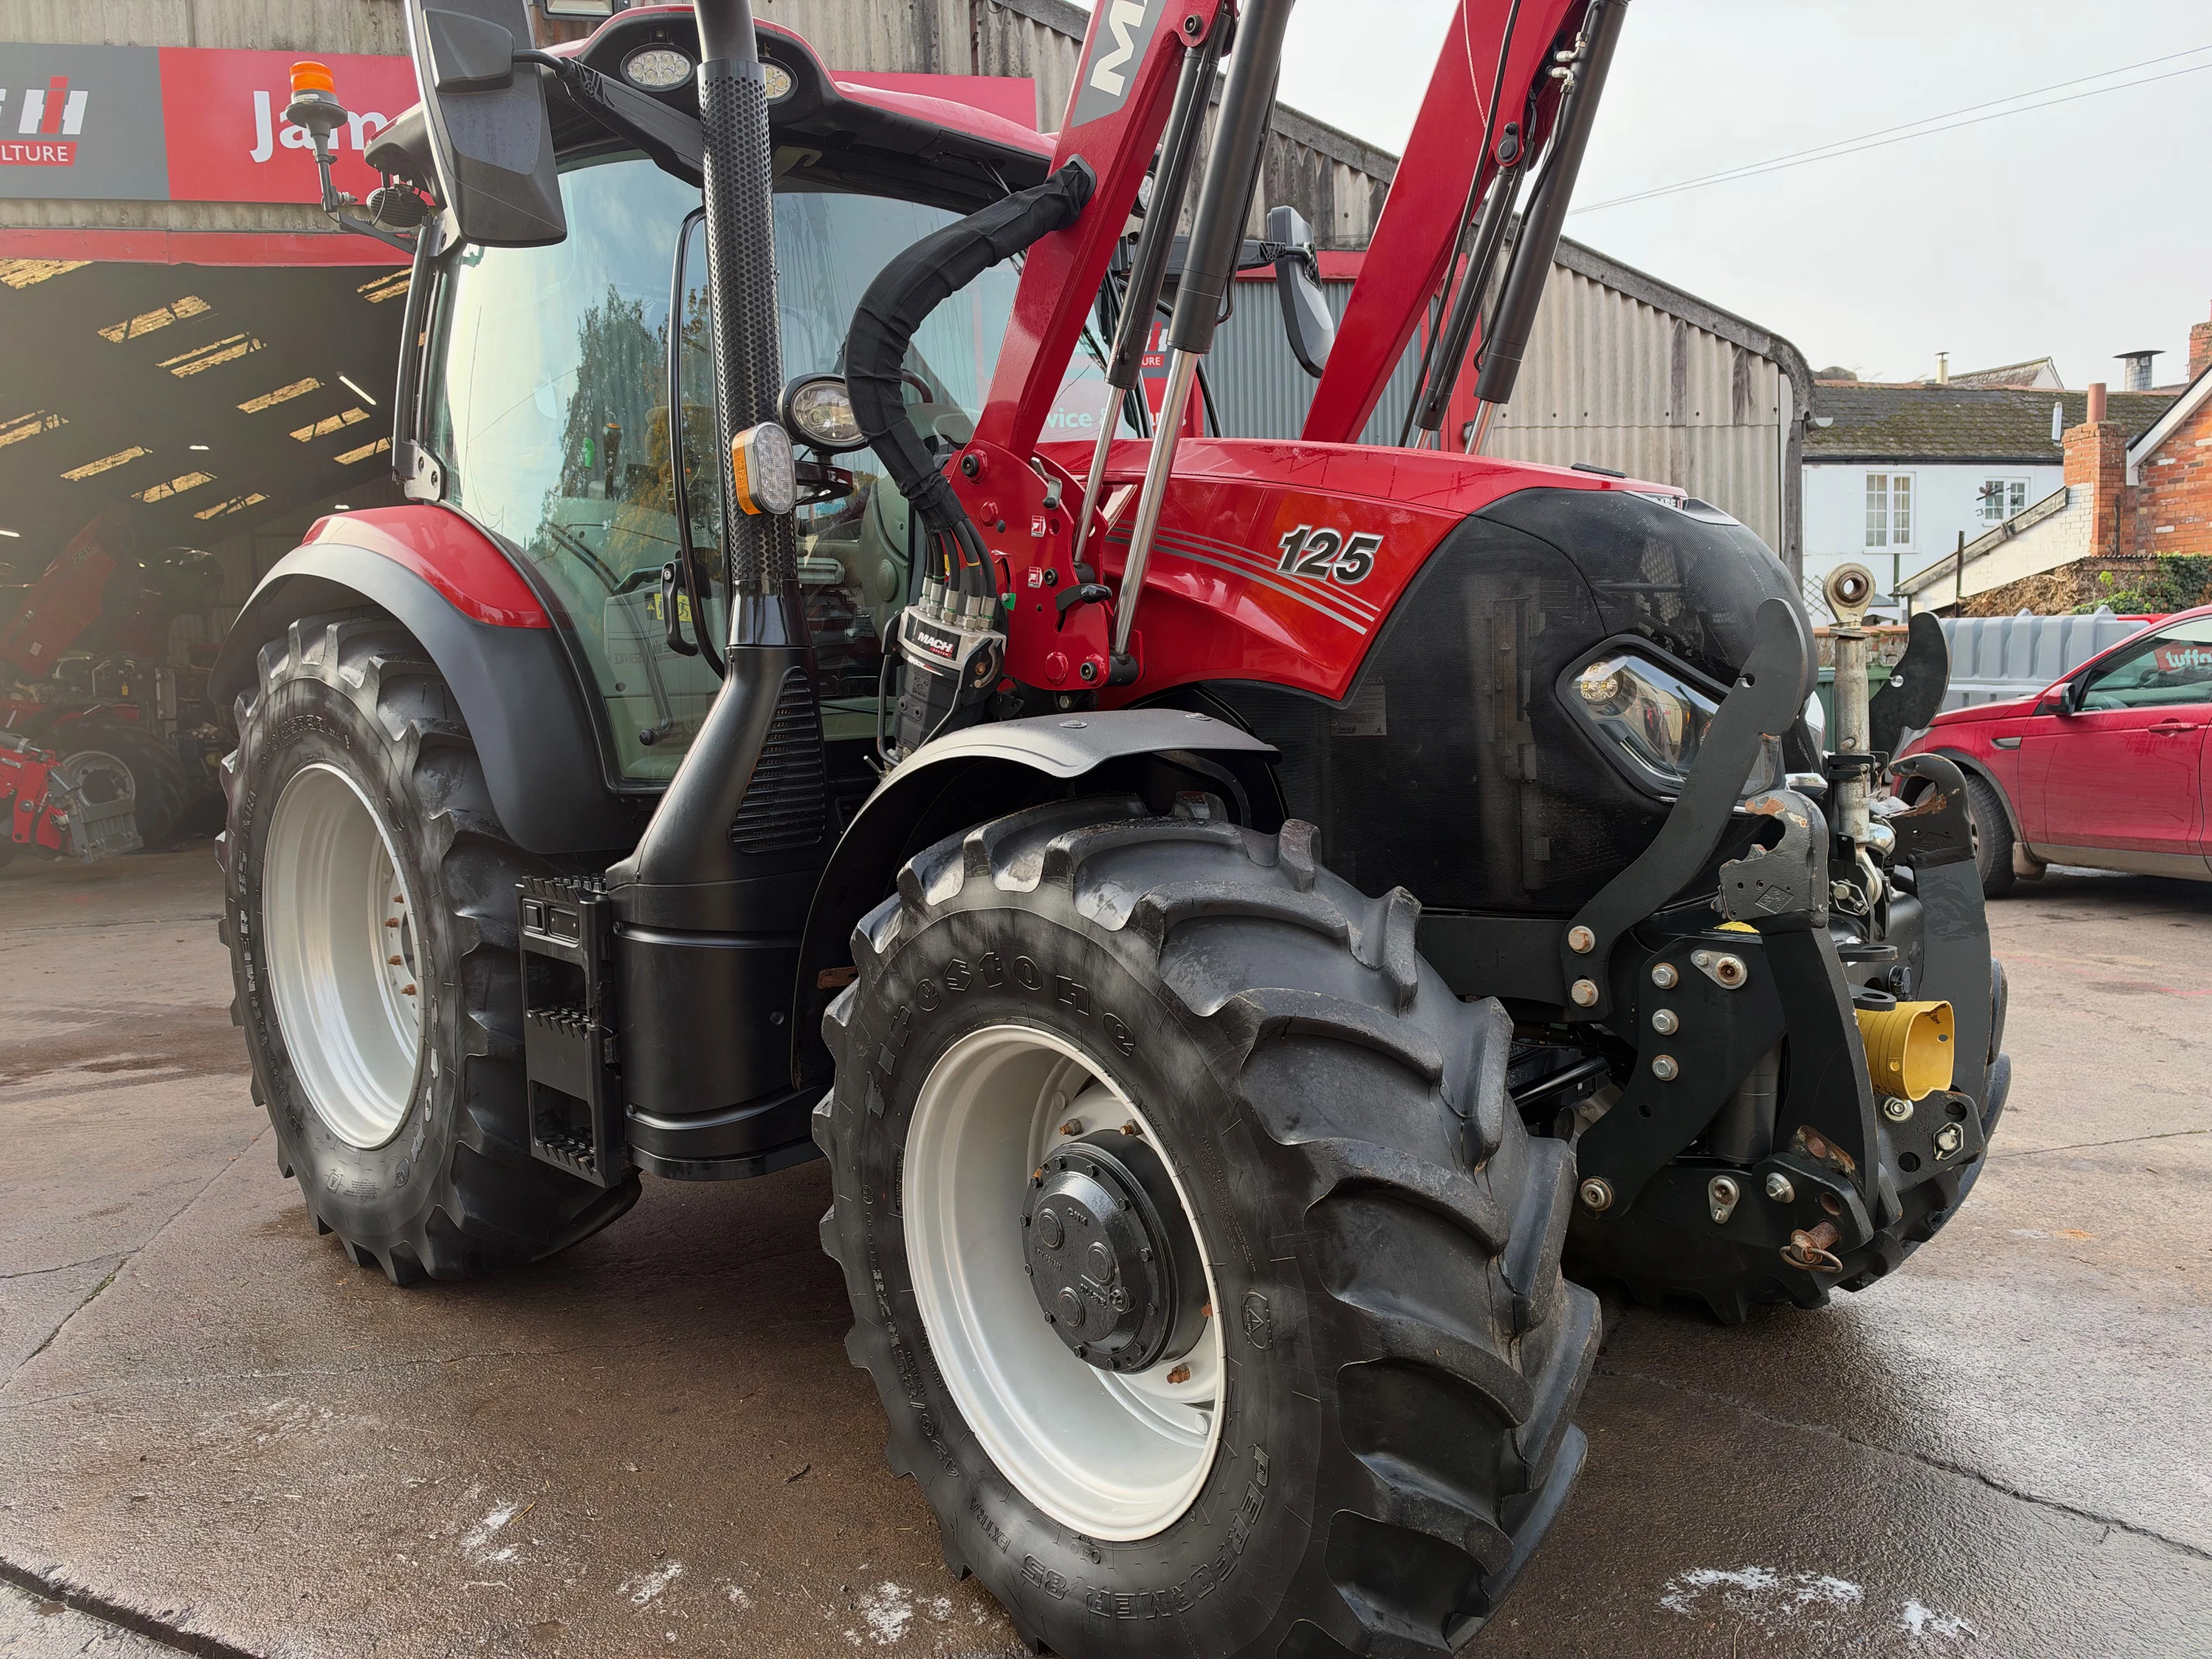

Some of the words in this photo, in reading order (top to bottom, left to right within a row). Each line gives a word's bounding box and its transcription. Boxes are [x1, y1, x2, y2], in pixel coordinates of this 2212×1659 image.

[1276, 524, 1385, 585] 125
[917, 631, 954, 653] MACH
[864, 952, 1135, 1119] Firestone
[969, 1494, 1012, 1555] EXTRA
[1086, 1443, 1270, 1620] PERFORMER
[1020, 1552, 1068, 1602] 85
